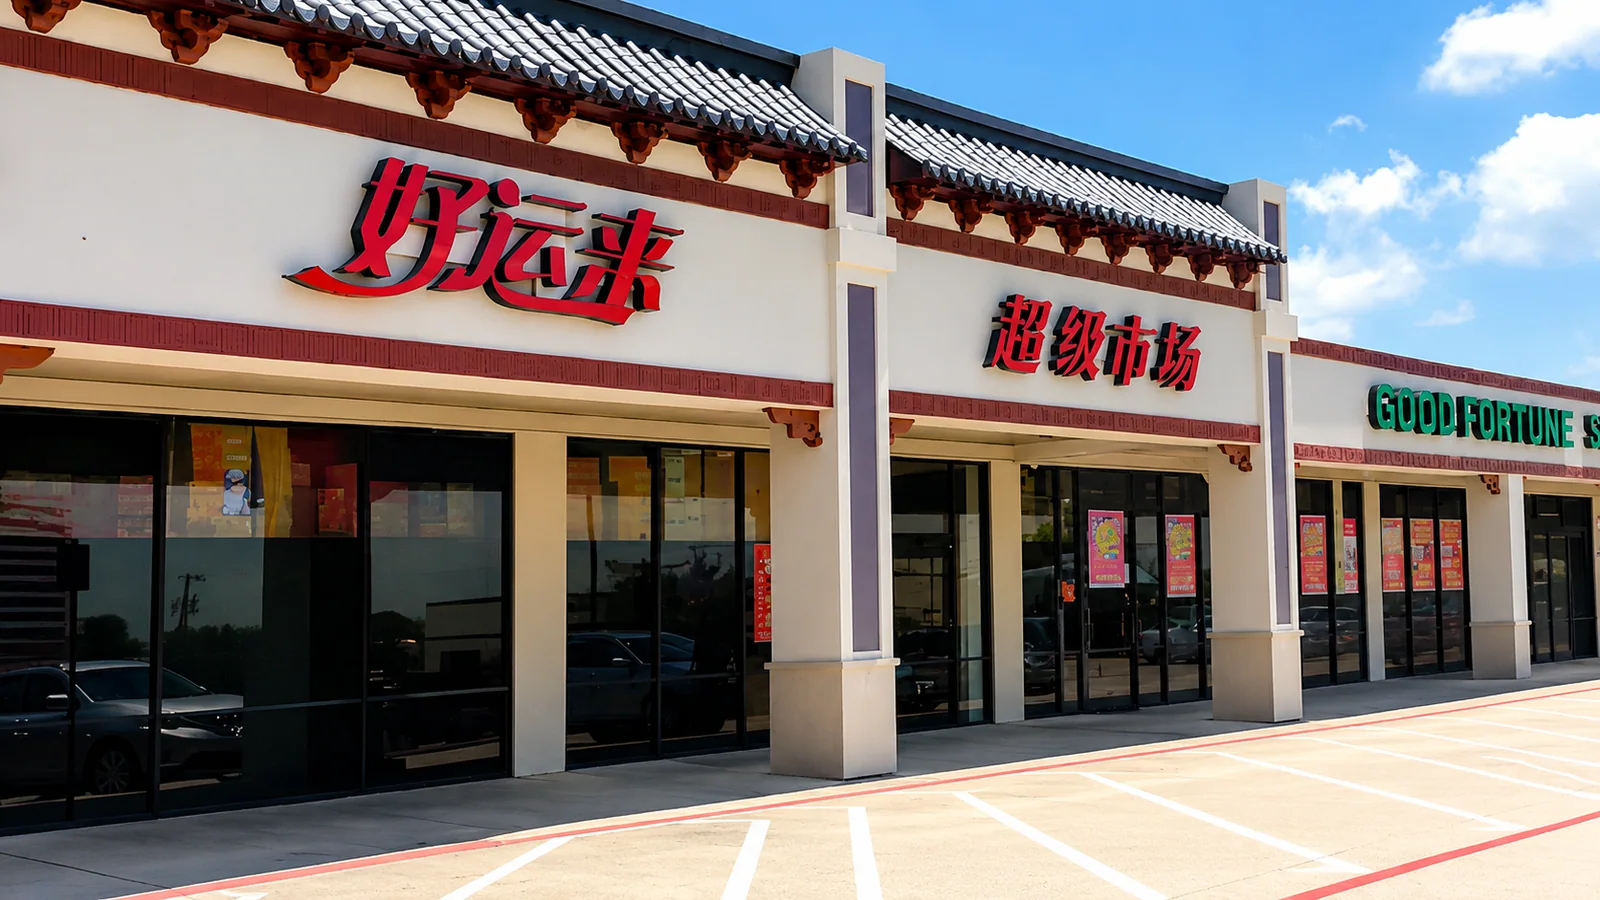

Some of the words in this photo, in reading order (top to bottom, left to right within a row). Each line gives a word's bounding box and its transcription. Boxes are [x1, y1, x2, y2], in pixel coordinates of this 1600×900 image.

[282, 156, 684, 326] 好运来
[983, 293, 1202, 391] 超级市场
[1368, 384, 1455, 436] GOOD
[1457, 396, 1574, 448] FORTUNE
